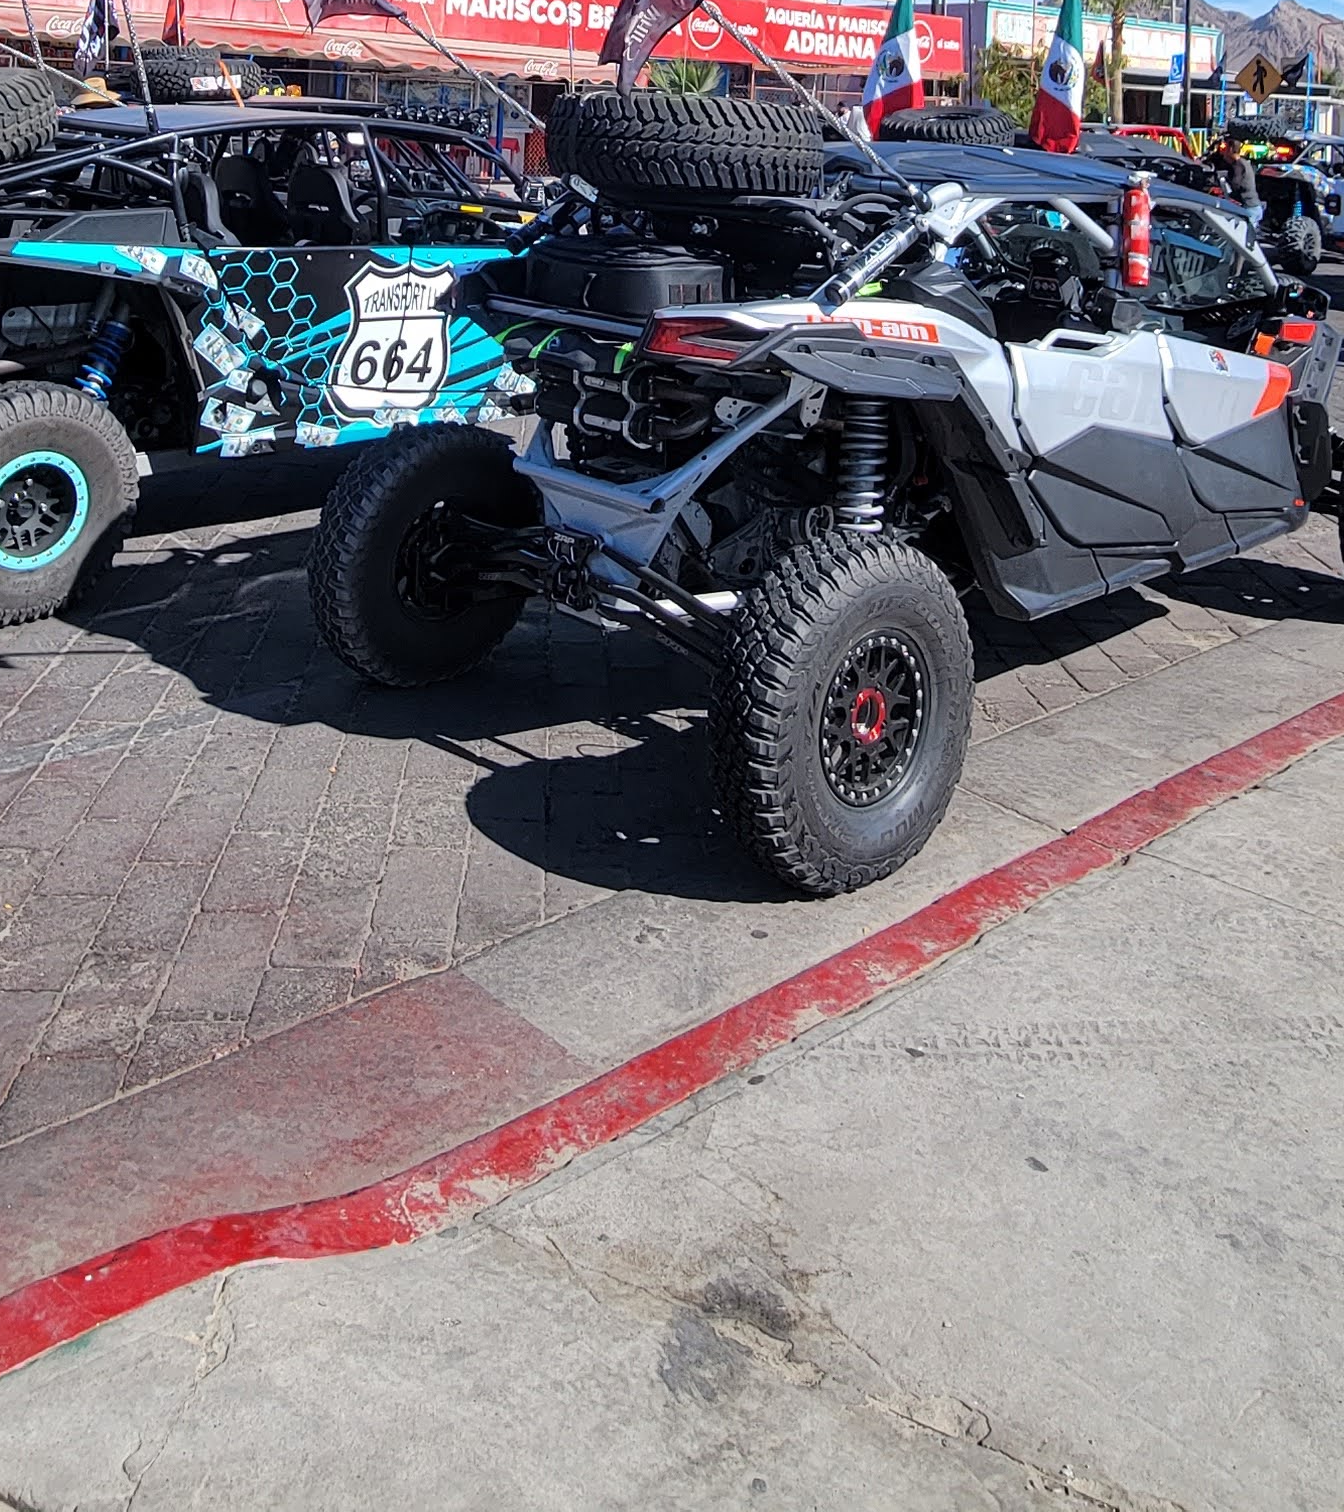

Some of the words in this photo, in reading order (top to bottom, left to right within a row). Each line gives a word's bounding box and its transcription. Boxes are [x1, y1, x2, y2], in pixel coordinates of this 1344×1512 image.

[45, 15, 84, 36] Coca-C
[766, 6, 825, 30] AQUERÍA
[826, 14, 838, 31] Y
[839, 16, 888, 37] MARISC
[323, 38, 364, 58] Coca-Cola
[783, 29, 877, 61] ADRIANA
[524, 58, 559, 77] Coca-Cola
[363, 281, 427, 314] TRANSPORT
[350, 337, 434, 386] 664
